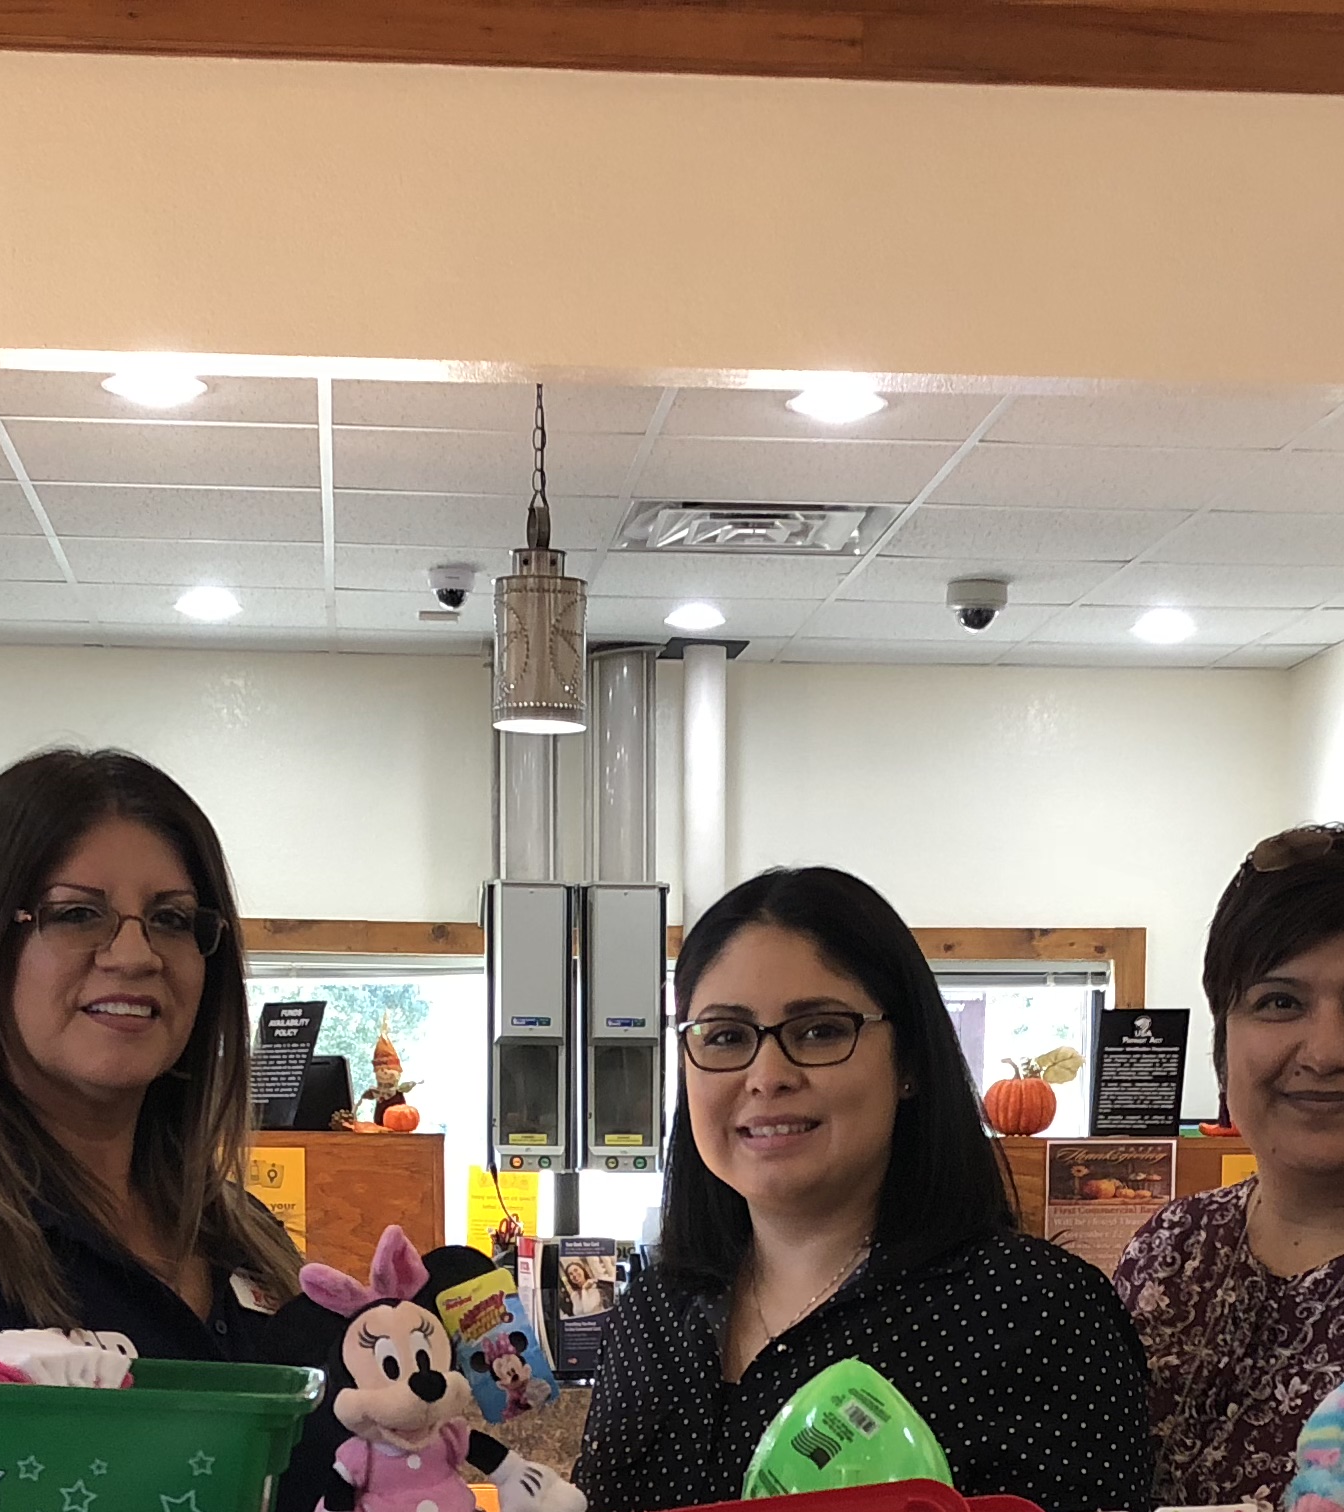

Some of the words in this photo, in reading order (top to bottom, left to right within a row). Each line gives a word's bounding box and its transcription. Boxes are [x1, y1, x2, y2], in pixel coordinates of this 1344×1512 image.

[274, 1028, 299, 1037] POLICY
[1056, 1147, 1168, 1165] Thanksgiving
[270, 1202, 296, 1212] your
